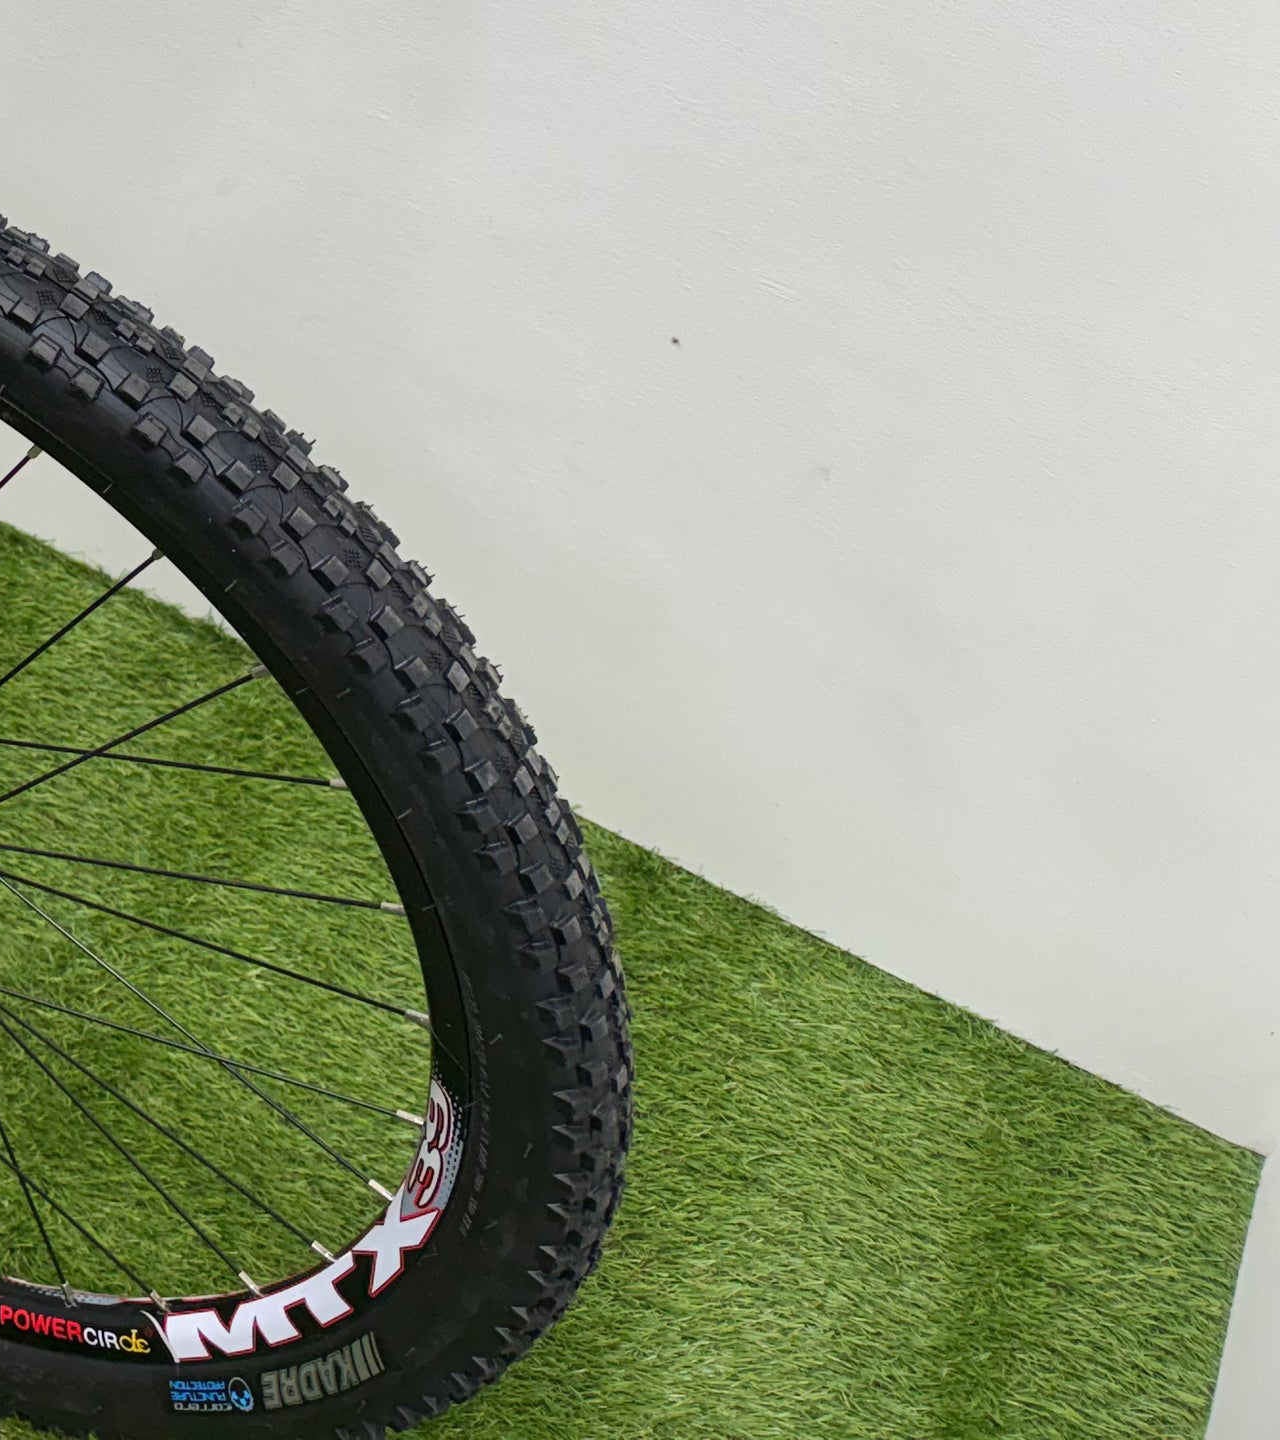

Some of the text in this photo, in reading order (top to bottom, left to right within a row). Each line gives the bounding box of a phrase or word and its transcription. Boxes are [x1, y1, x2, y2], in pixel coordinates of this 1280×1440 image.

[164, 1180, 442, 1362] MTX
[169, 1380, 226, 1391] PROTECTION
[171, 1391, 227, 1402] PUNCTURE
[173, 1402, 233, 1413] carrera
